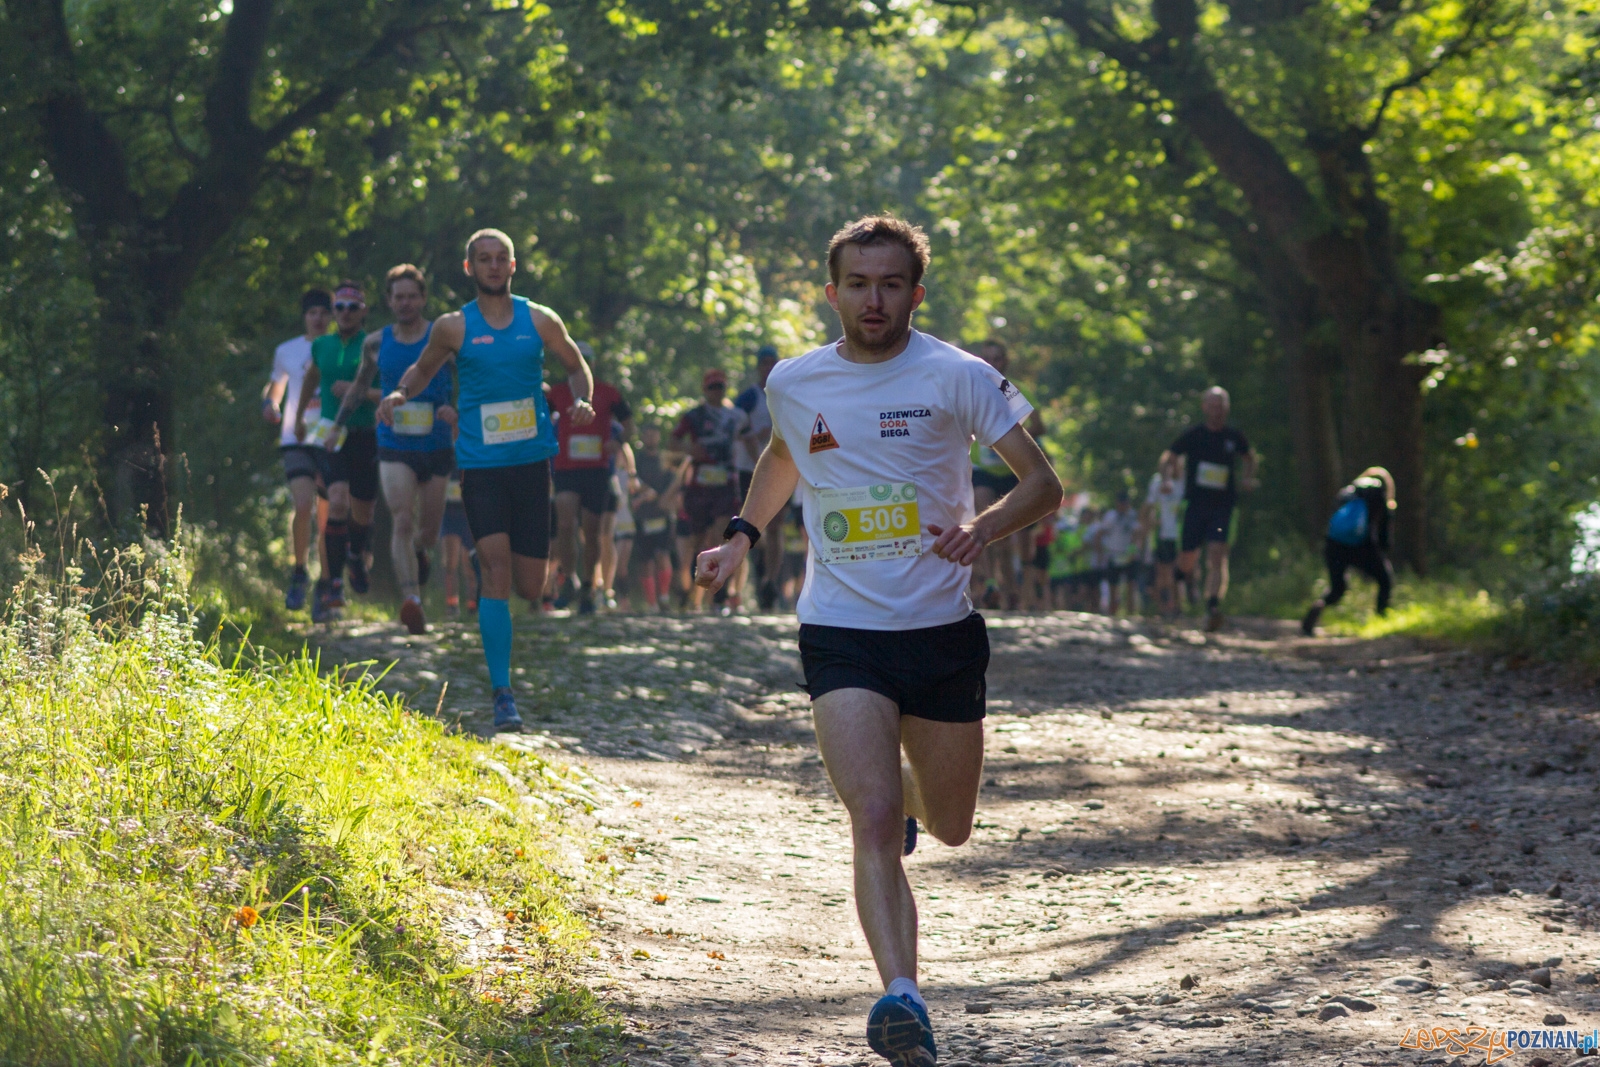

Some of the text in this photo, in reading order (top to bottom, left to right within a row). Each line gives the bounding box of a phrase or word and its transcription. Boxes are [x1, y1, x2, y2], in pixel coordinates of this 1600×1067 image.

[506, 411, 530, 427] 273
[880, 409, 931, 419] DZIEWICZA
[880, 418, 908, 428] GÓRA
[881, 429, 910, 438] BIEGA
[812, 434, 830, 445] DGB!
[859, 506, 907, 533] 506
